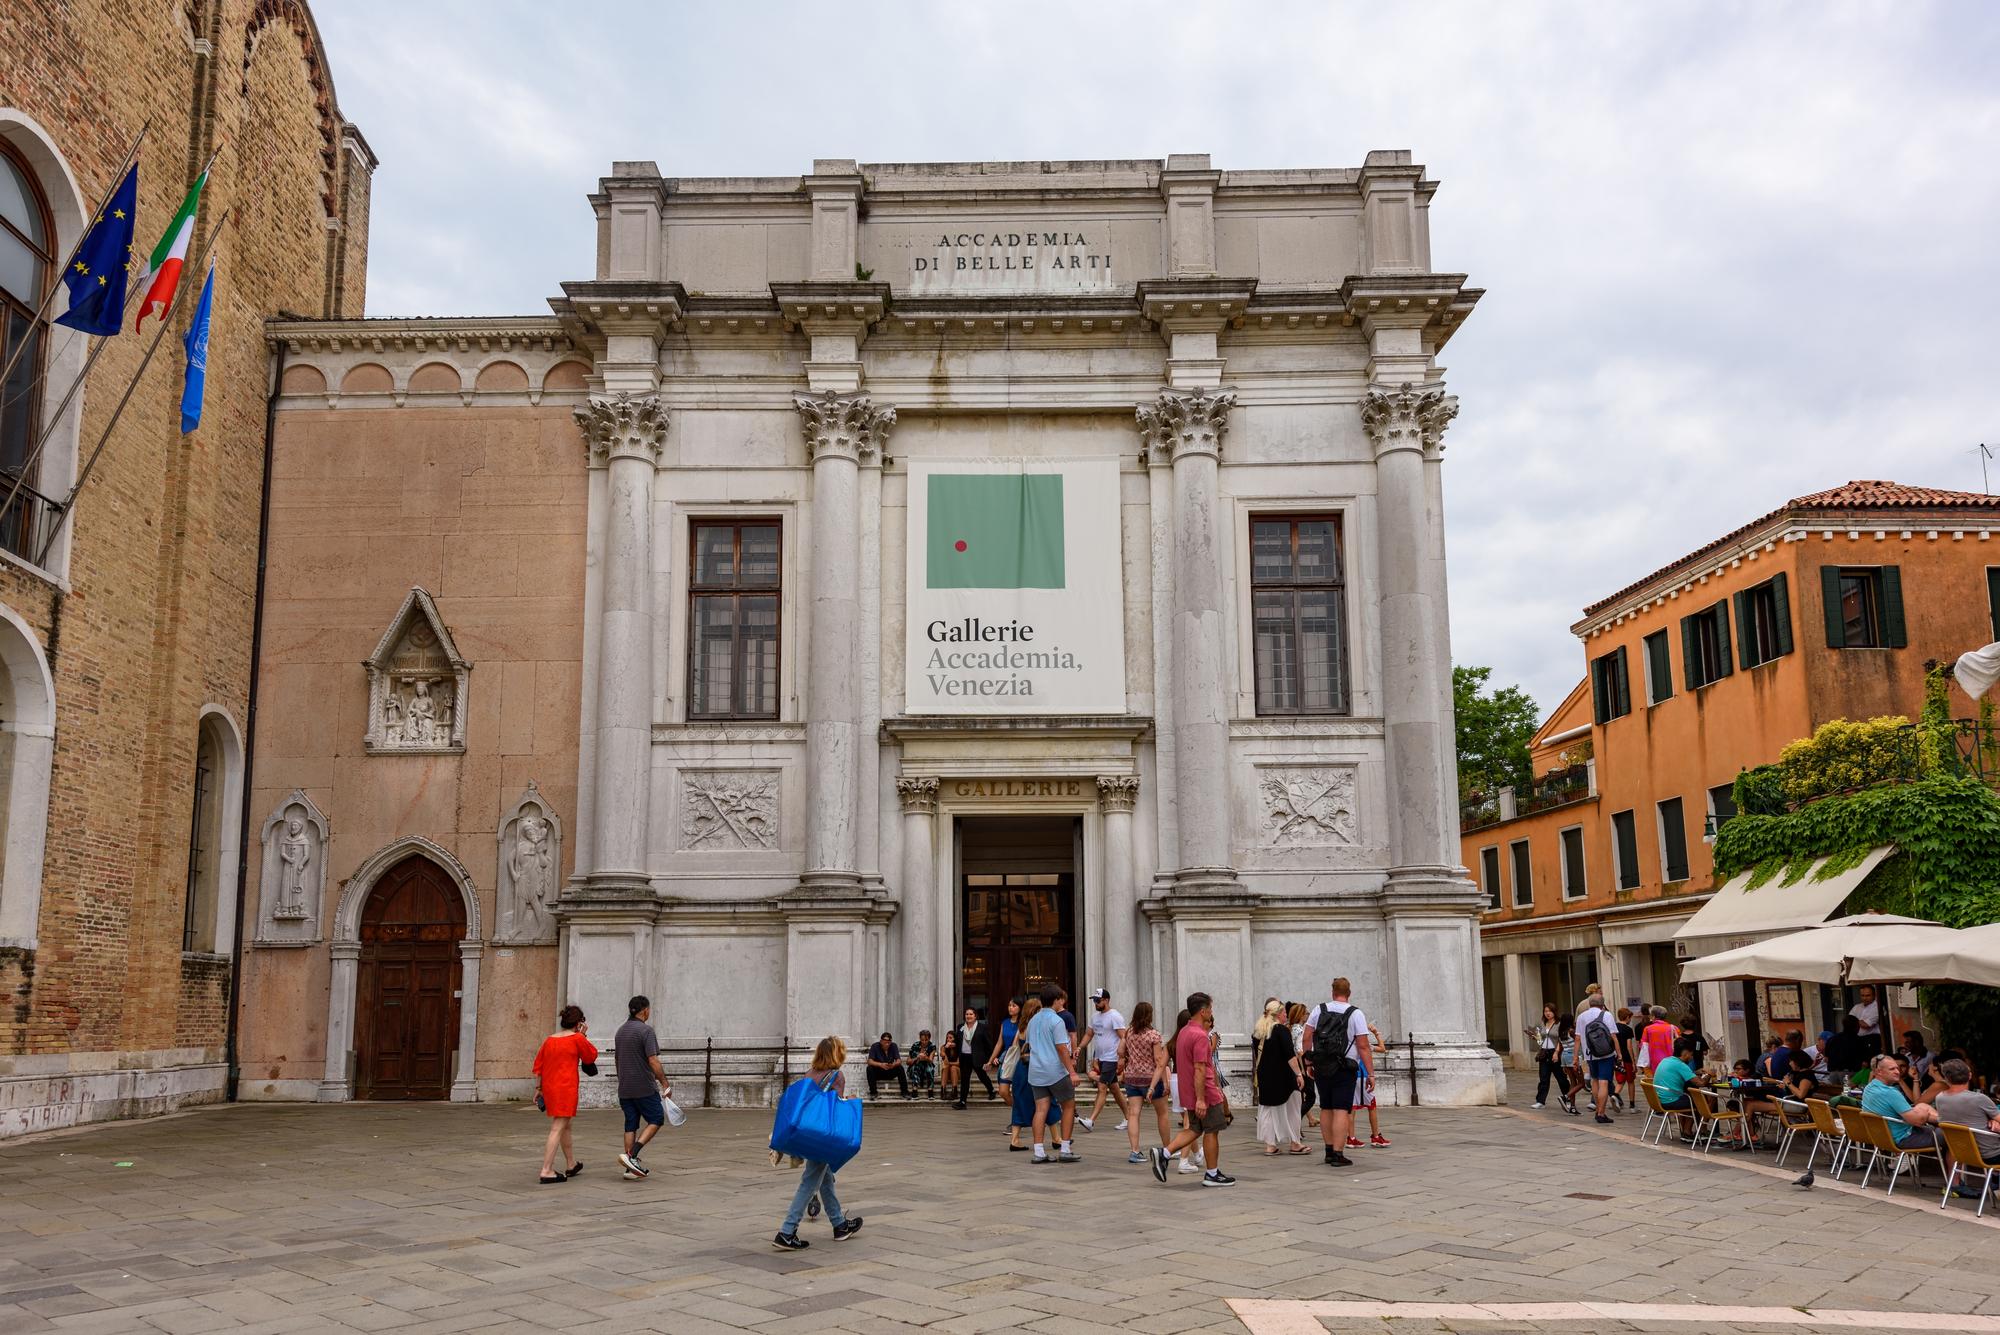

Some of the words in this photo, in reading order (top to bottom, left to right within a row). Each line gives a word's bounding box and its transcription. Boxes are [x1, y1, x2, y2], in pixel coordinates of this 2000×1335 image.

[939, 233, 1086, 247] ACCADEMIA
[914, 257, 940, 271] DI
[955, 255, 1034, 270] BELLE
[1052, 254, 1112, 269] ARTI
[926, 617, 1034, 643] Gallerie
[926, 645, 1083, 672] Accademia,
[926, 672, 1035, 696] Venezia
[955, 781, 1080, 797] GALLERIE
